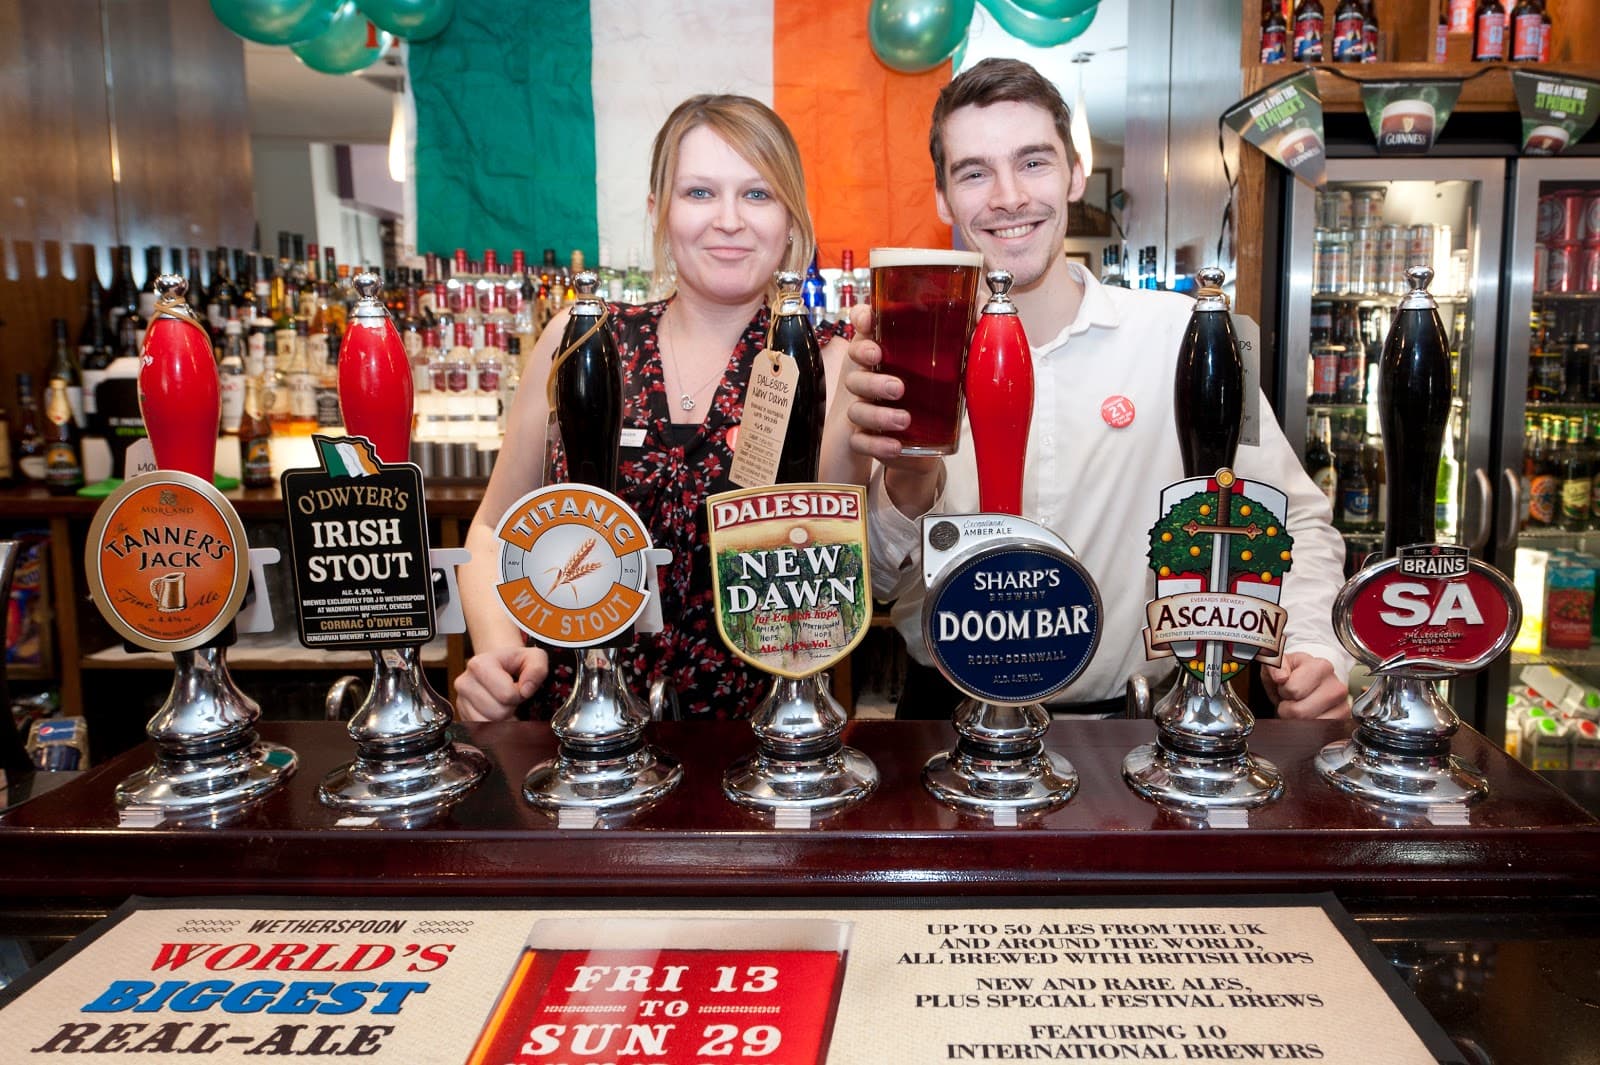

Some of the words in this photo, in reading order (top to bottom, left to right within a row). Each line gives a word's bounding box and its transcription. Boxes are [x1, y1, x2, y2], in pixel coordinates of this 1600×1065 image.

[1385, 132, 1427, 145] GUINNESS
[757, 374, 790, 394] DALESIDE
[1109, 402, 1127, 419] 21
[298, 485, 409, 515] O'DWYER'S
[141, 506, 194, 517] MORLAND
[714, 493, 858, 530] DALESIDE
[511, 495, 636, 549] TITANIC
[311, 518, 403, 548] IRISH
[964, 528, 993, 536] AMBER
[996, 527, 1013, 535] ALE
[105, 526, 231, 560] TANNER'S
[138, 551, 201, 570] JACK
[308, 552, 413, 583] STOUT
[738, 545, 842, 580] NEW
[1404, 558, 1464, 574] BRAINS
[973, 568, 1060, 591] SHARP'S
[327, 597, 362, 605] EXCLUSIVELY
[385, 594, 425, 603] WETHERSPOON
[726, 576, 857, 614] DAWN
[989, 590, 1046, 602] BREWERY
[1219, 598, 1246, 606] BREWERY
[325, 605, 359, 613] WADWORTH
[389, 602, 413, 610] DEVIZES
[511, 588, 554, 628] WIT
[560, 592, 632, 636] STOUT
[1379, 582, 1485, 627] SA
[320, 619, 364, 631] CORMAC
[366, 616, 413, 628] O'DWYER
[753, 614, 770, 627] for
[773, 611, 811, 623] English
[814, 608, 838, 621] hops
[938, 609, 1032, 642] DOOM
[1036, 604, 1091, 639] BAR
[1155, 604, 1282, 638] ASCALON
[339, 632, 365, 640] BREWERY
[369, 631, 401, 639] WATERFORD
[1208, 630, 1240, 638] COURAGEOUS
[1241, 633, 1261, 641] ORANGE
[760, 644, 780, 654] Alc.
[811, 639, 832, 649] Vol.
[1005, 650, 1066, 664] CORNWALL
[248, 919, 407, 934] WETHERSPOON
[927, 924, 961, 935] UP
[965, 924, 999, 935] TO
[1004, 924, 1032, 935] 50
[1038, 924, 1096, 935] ALES
[1100, 924, 1170, 935] FROM
[1173, 924, 1227, 935] THE
[1229, 924, 1268, 935] UK
[939, 938, 993, 950] AND
[997, 938, 1101, 950] AROUND
[1105, 938, 1159, 950] THE
[1162, 938, 1264, 952] WORLD,
[150, 943, 456, 972] WORLD'S
[896, 952, 944, 965] ALL
[950, 952, 1059, 965] BREWED
[1065, 952, 1131, 965] WITH
[1139, 952, 1240, 965] BRITISH
[1243, 952, 1315, 965] HOPS
[564, 965, 689, 992] FRI
[710, 965, 779, 992] 13
[976, 978, 1034, 991] NEW
[1042, 978, 1098, 991] AND
[1104, 978, 1176, 991] RARE
[1181, 978, 1253, 993] ALES,
[80, 980, 431, 1015] BIGGEST
[915, 994, 981, 1008] PLUS
[986, 994, 1096, 1008] SPECIAL
[1100, 994, 1225, 1008] FESTIVAL
[1230, 994, 1325, 1008] BREWS
[639, 999, 688, 1017] TO
[30, 1022, 397, 1055] REAL-ALE
[520, 1023, 675, 1056] SUN
[696, 1023, 782, 1056] 29
[1030, 1025, 1186, 1040] FEATURING
[1194, 1025, 1227, 1040] 10
[947, 1043, 1181, 1059] INTERNATIONAL
[1183, 1043, 1325, 1059] BREWERS
